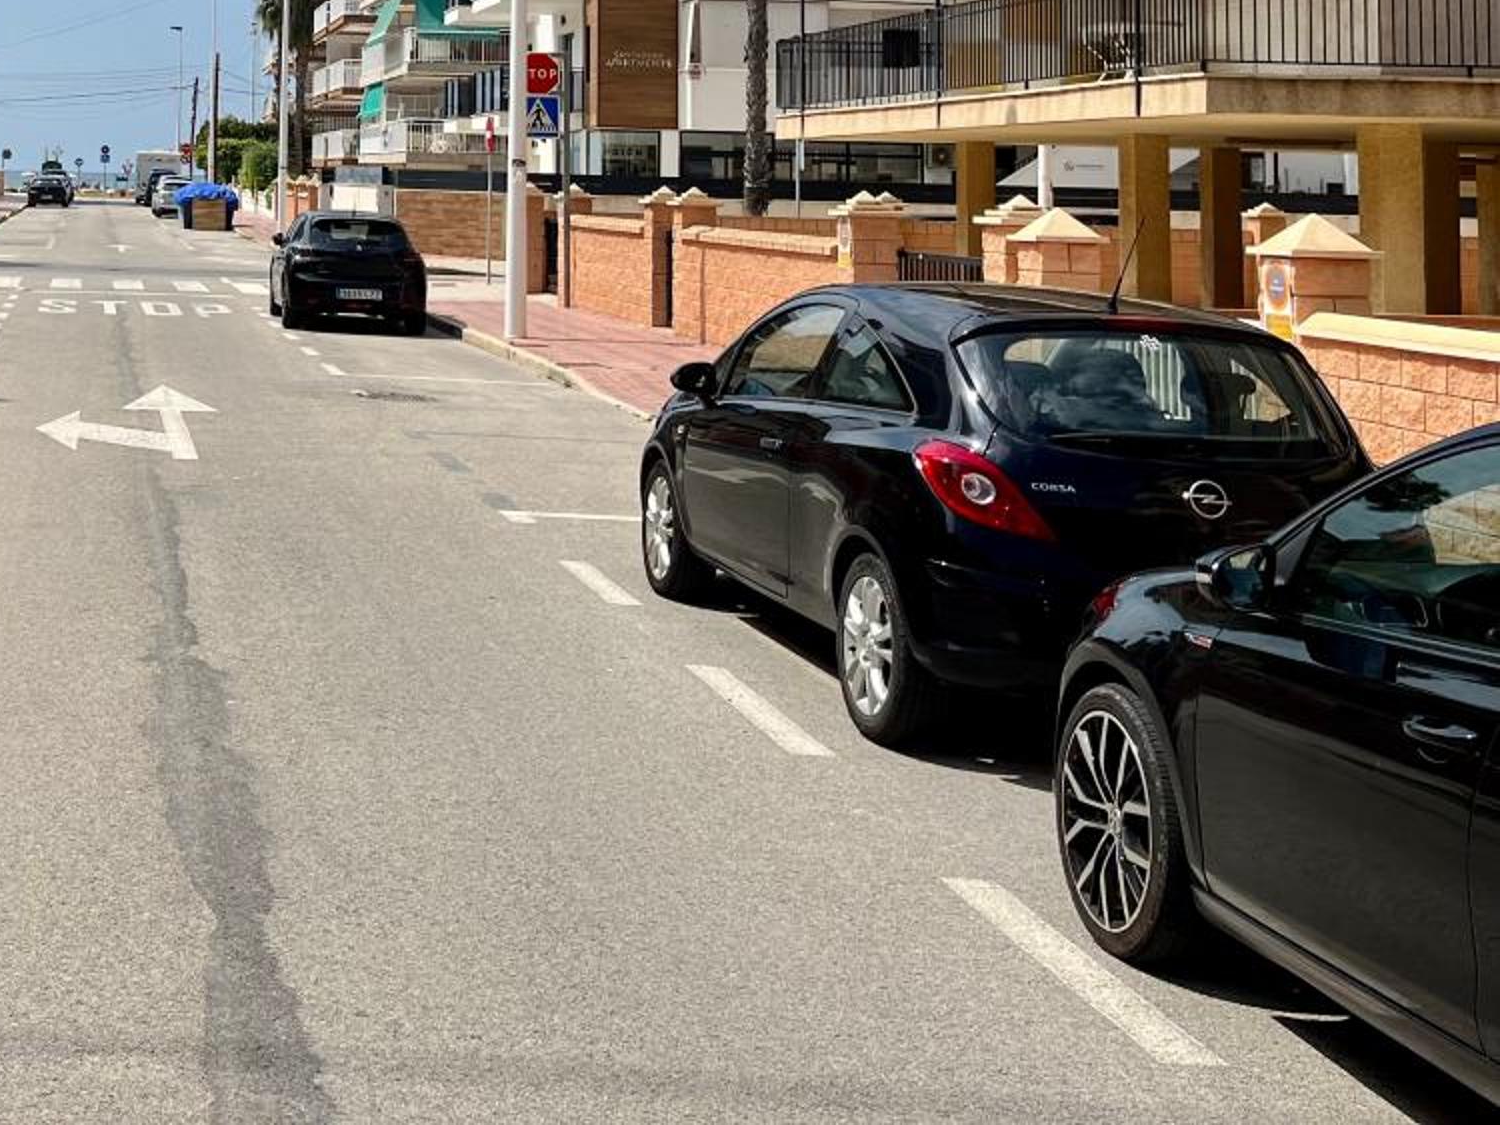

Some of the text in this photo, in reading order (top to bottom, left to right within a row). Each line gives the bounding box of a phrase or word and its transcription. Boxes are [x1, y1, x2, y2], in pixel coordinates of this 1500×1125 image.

[526, 68, 557, 79] TOP
[37, 298, 232, 318] STOP
[1031, 482, 1077, 494] CORSA
